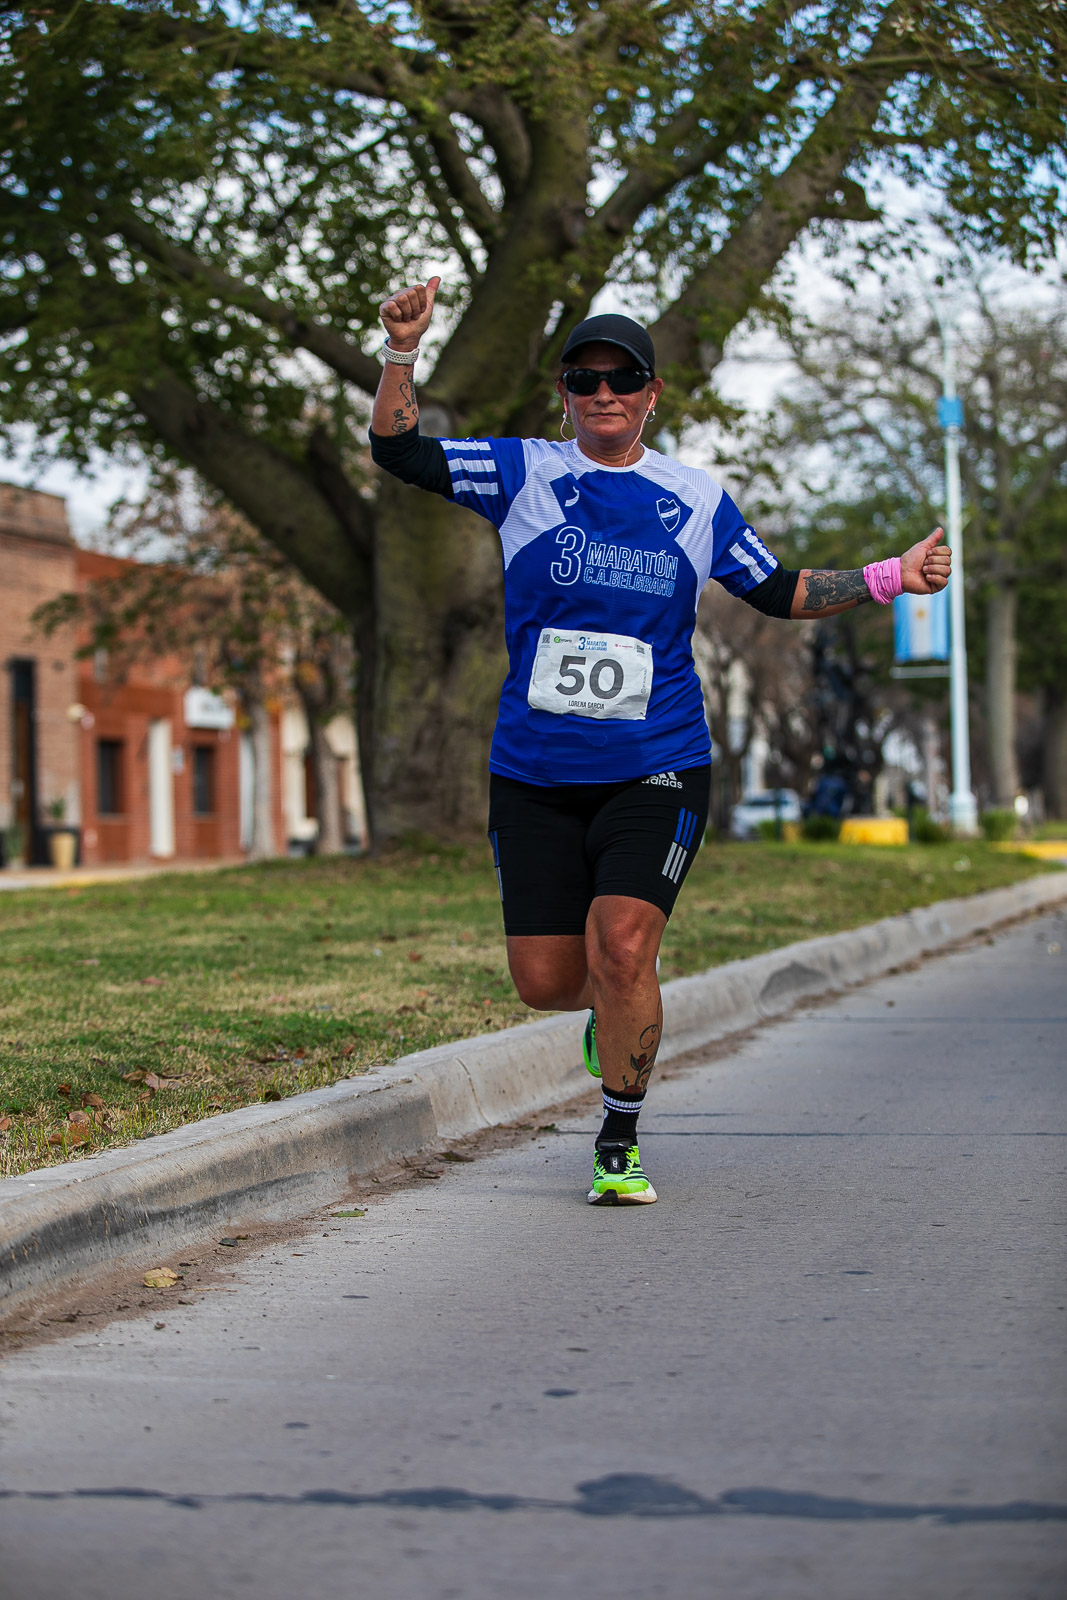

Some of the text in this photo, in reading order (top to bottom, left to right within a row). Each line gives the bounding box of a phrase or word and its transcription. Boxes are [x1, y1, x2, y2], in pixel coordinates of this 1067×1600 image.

[550, 525, 678, 586] 3 MARATÓN
[583, 567, 675, 597] C.A.BELGRANO
[578, 636, 586, 651] 3
[555, 654, 624, 700] 50
[568, 700, 605, 710] LORENA GARCIA
